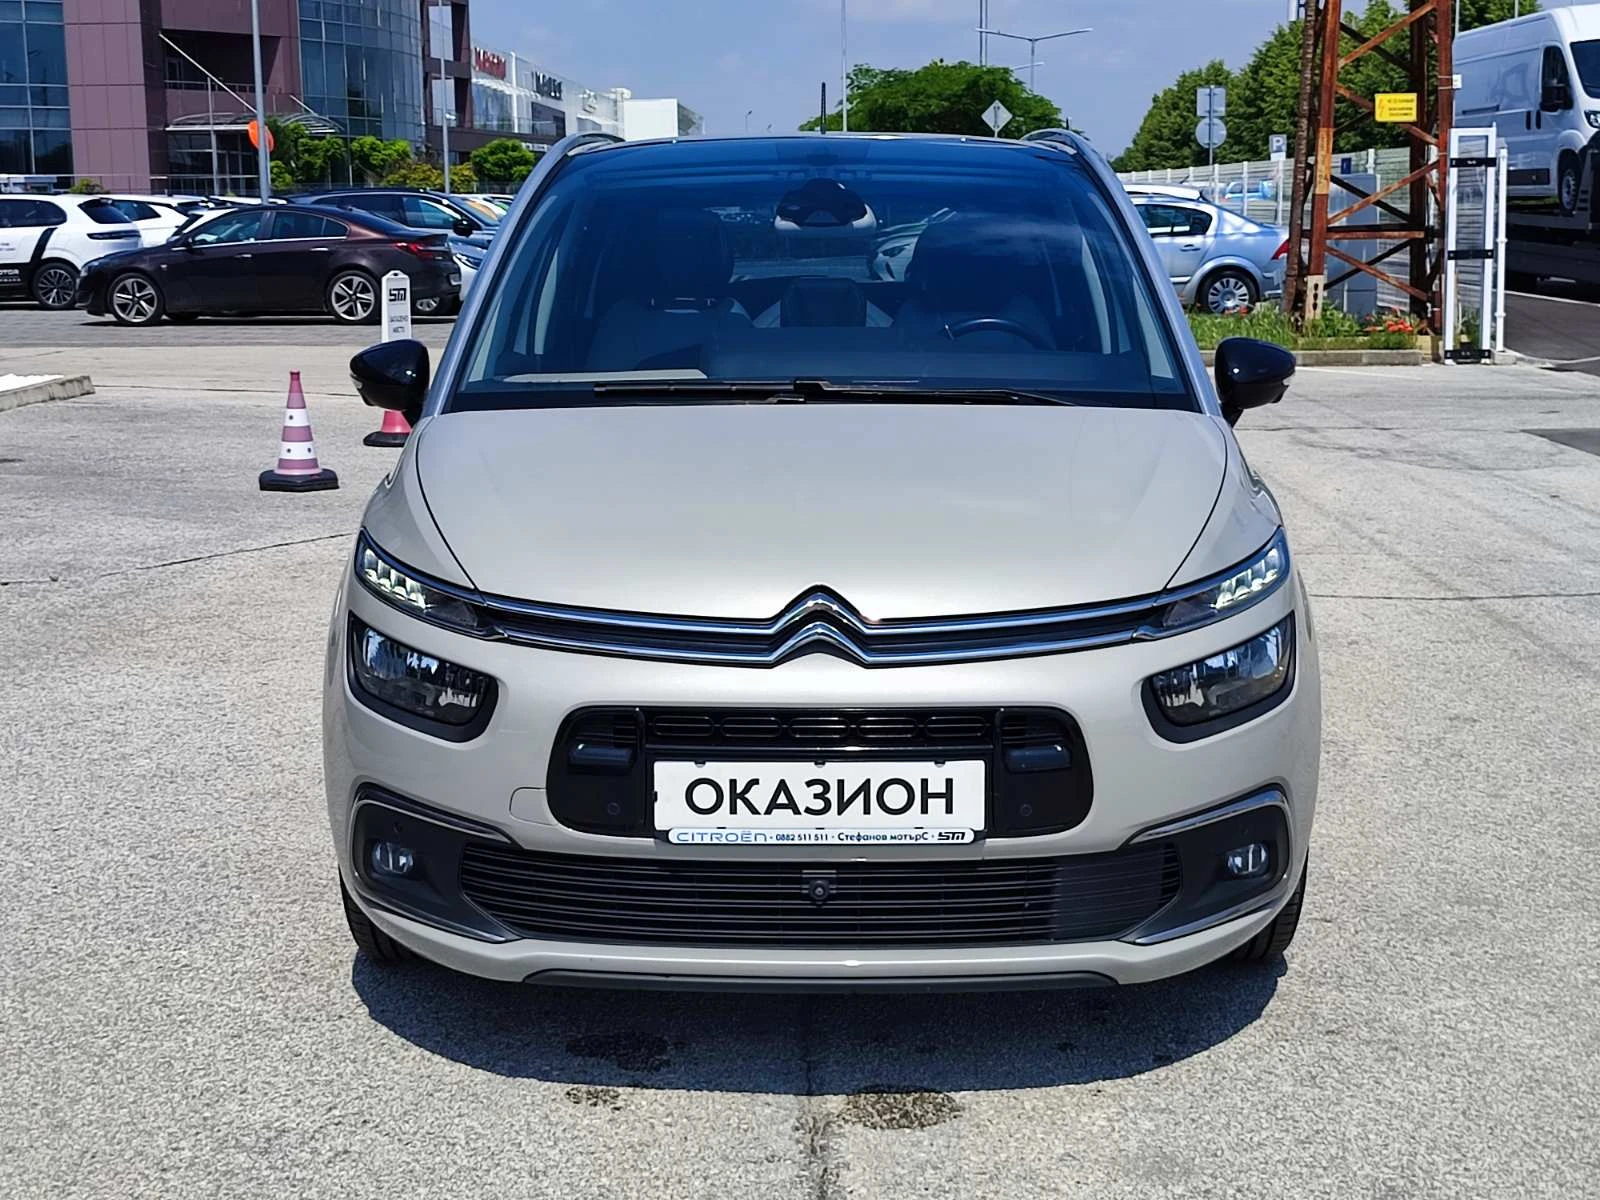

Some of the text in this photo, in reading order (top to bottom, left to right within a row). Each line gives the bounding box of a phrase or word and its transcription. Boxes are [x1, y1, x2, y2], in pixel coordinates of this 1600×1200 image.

[1272, 136, 1284, 152] P
[685, 778, 953, 816] ОКАЗИОН
[775, 833, 795, 841] 0882
[798, 833, 812, 841] 511
[815, 833, 828, 841] 511
[838, 832, 887, 842] Стефанов
